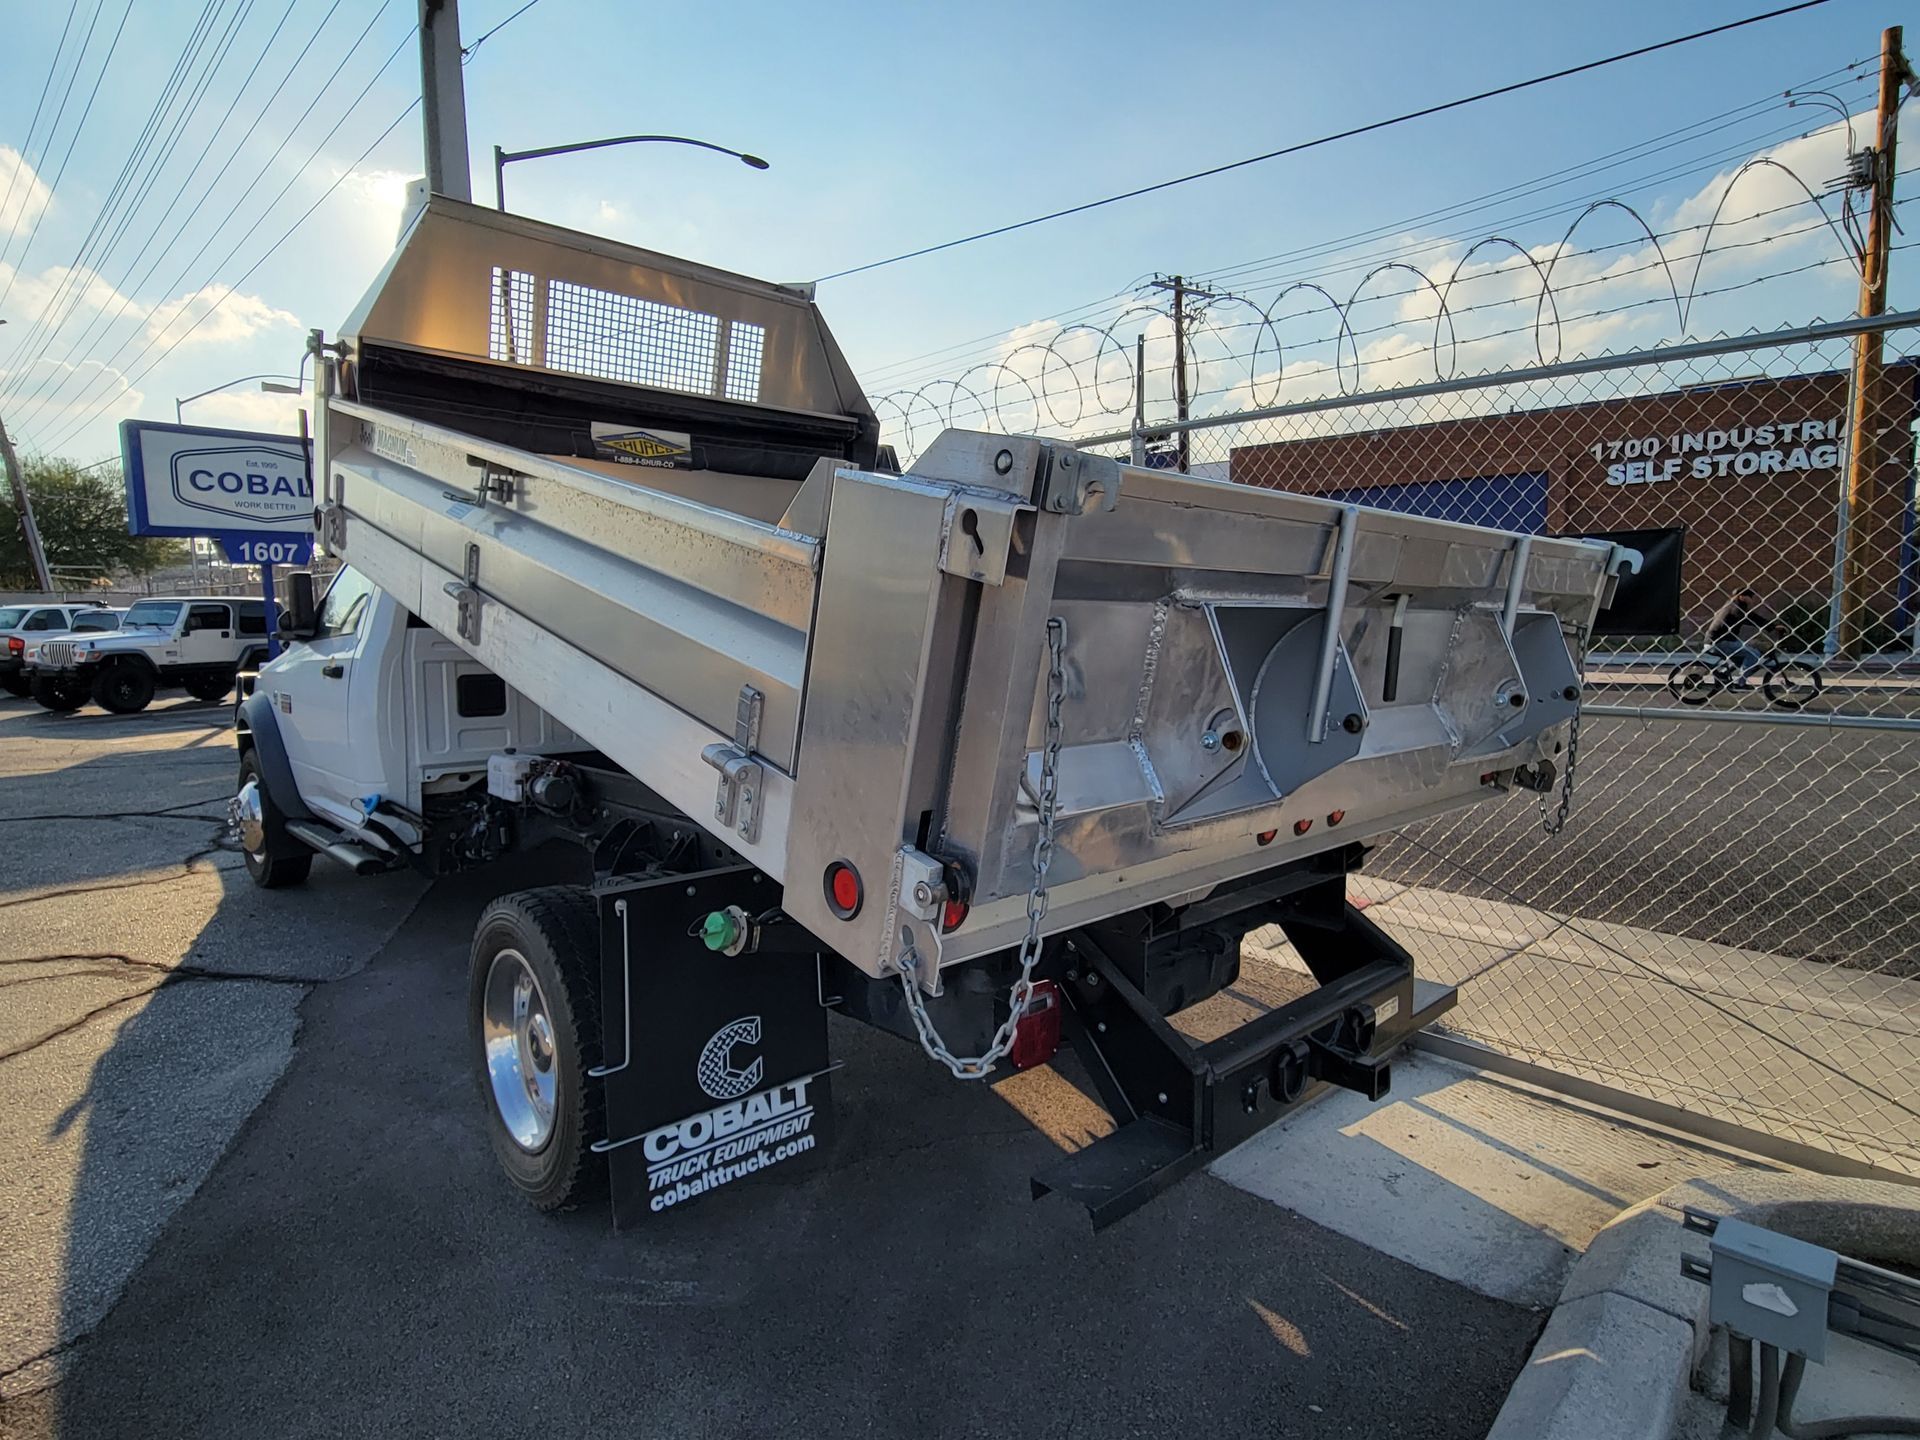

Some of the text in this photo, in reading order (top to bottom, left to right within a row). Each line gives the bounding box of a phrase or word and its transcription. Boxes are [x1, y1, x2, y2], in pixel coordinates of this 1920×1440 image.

[1590, 419, 1888, 462] 1700 INDUSTRI
[189, 469, 312, 498] COBAL
[1606, 458, 1682, 487] SELF
[234, 501, 296, 511] WORK BETTER
[239, 541, 298, 562] 1607
[643, 1077, 813, 1162] COBALT
[648, 1111, 815, 1192] TRUCK EQUIPMENT
[650, 1134, 816, 1212] cobalttruck.com
